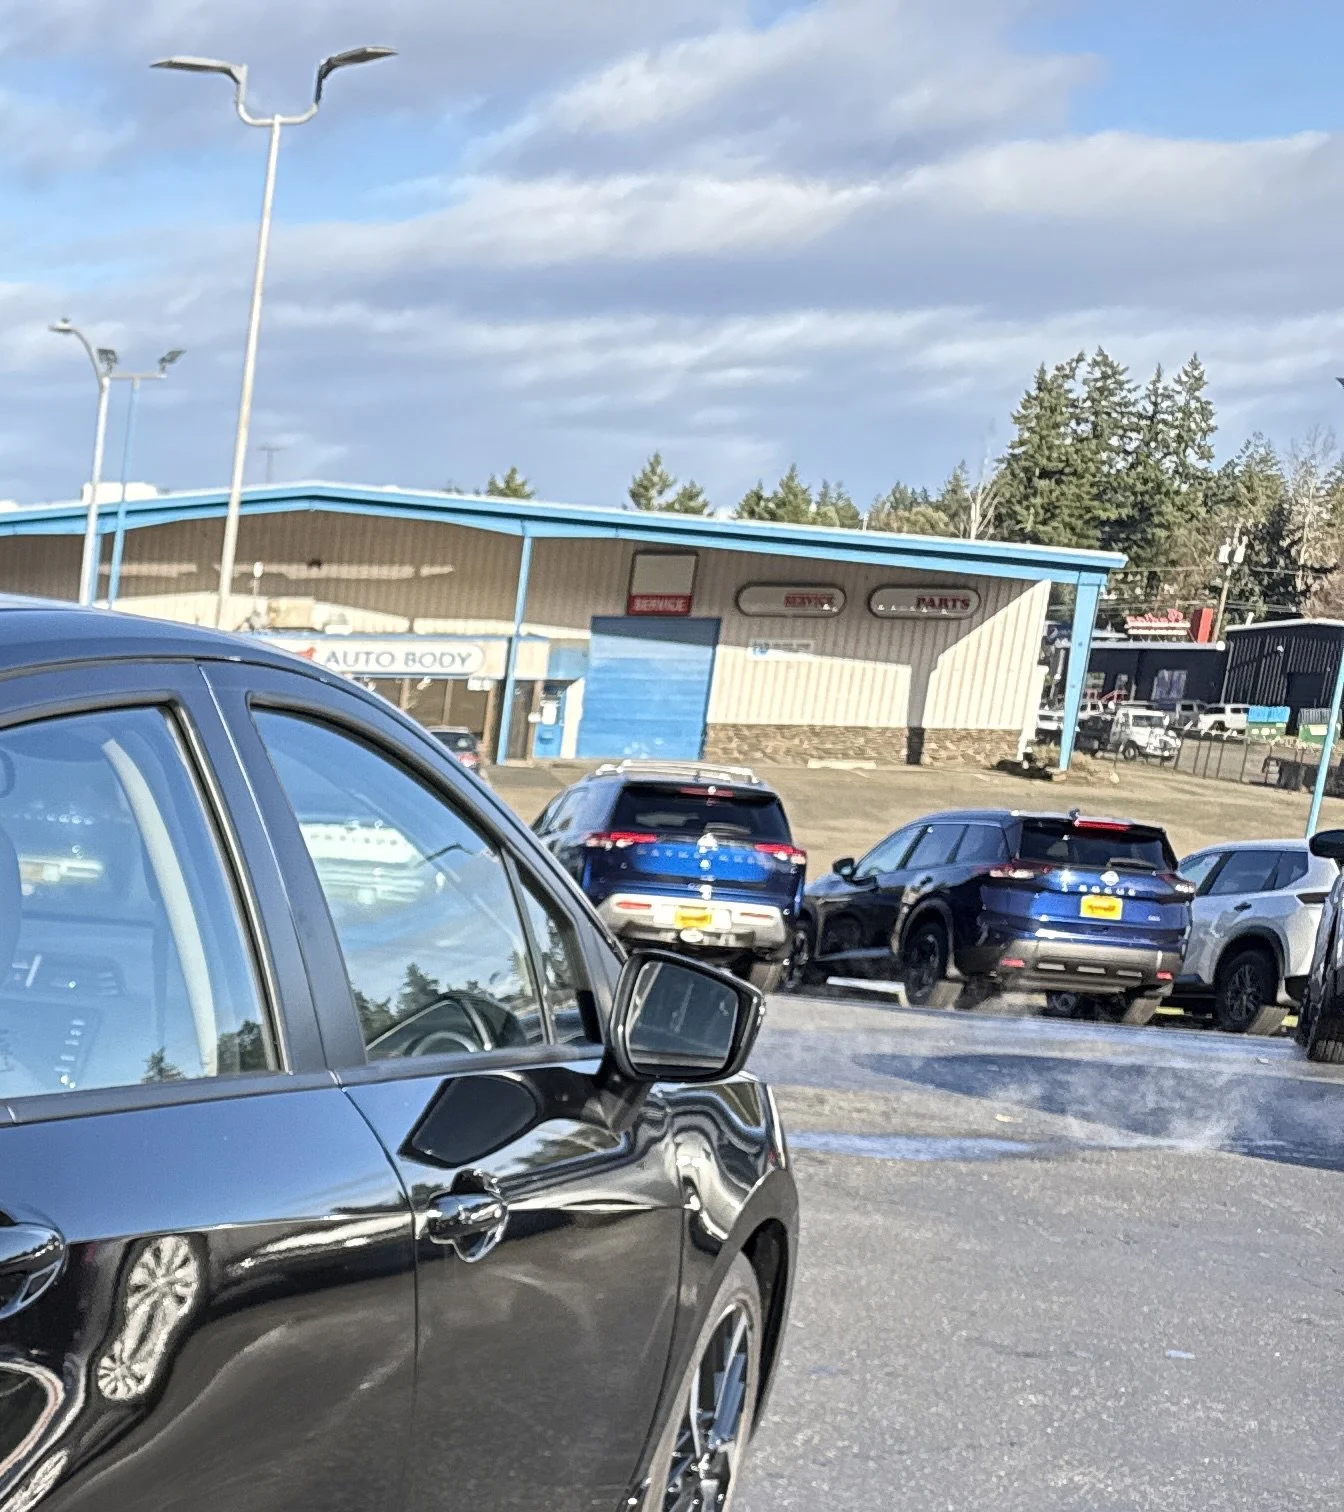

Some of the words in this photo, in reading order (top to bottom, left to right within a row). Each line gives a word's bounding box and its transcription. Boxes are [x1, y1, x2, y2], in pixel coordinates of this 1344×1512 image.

[916, 596, 970, 610] PARTS
[325, 650, 395, 669] AUTO
[404, 651, 473, 669] BODY
